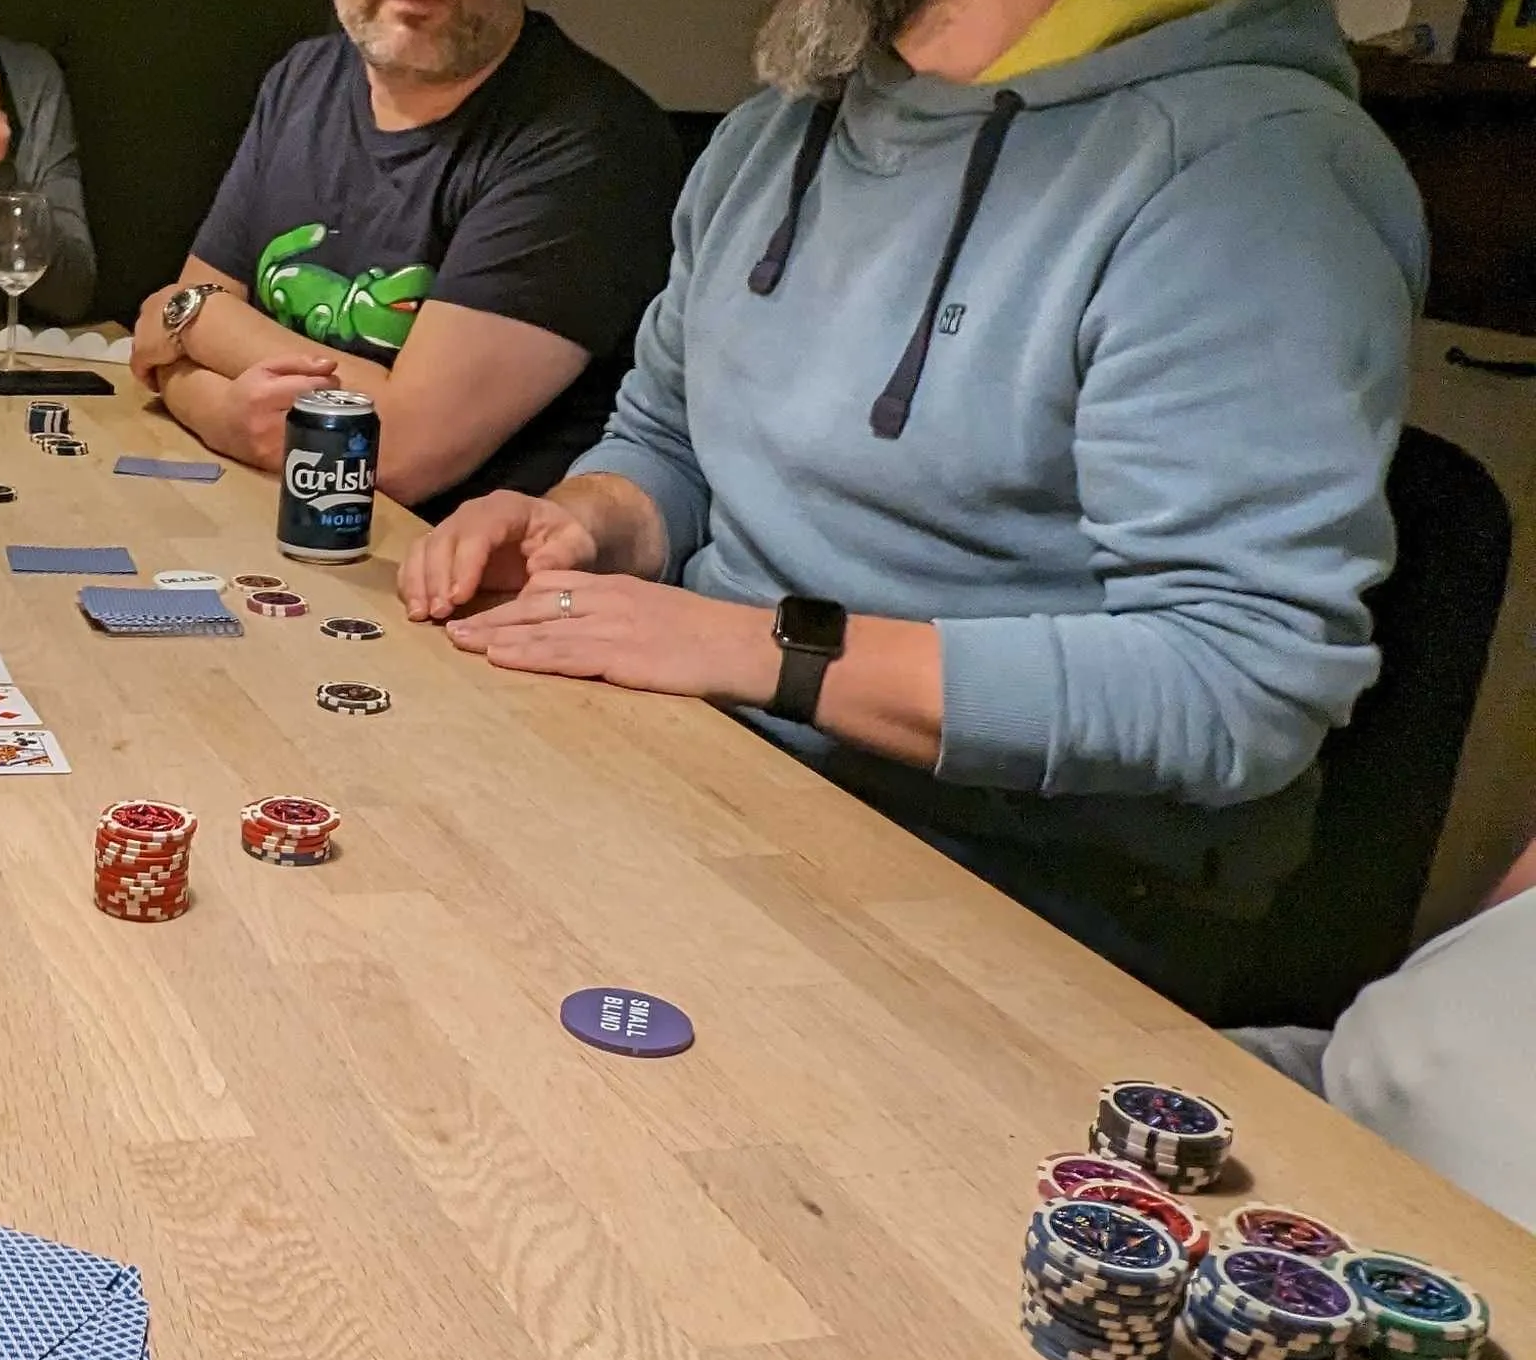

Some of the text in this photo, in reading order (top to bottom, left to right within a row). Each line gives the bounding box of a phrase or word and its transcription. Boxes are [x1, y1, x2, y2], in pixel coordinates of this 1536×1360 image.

[159, 575, 217, 584] DEALER
[600, 995, 624, 1032] BLIND
[626, 998, 650, 1037] SMALL
